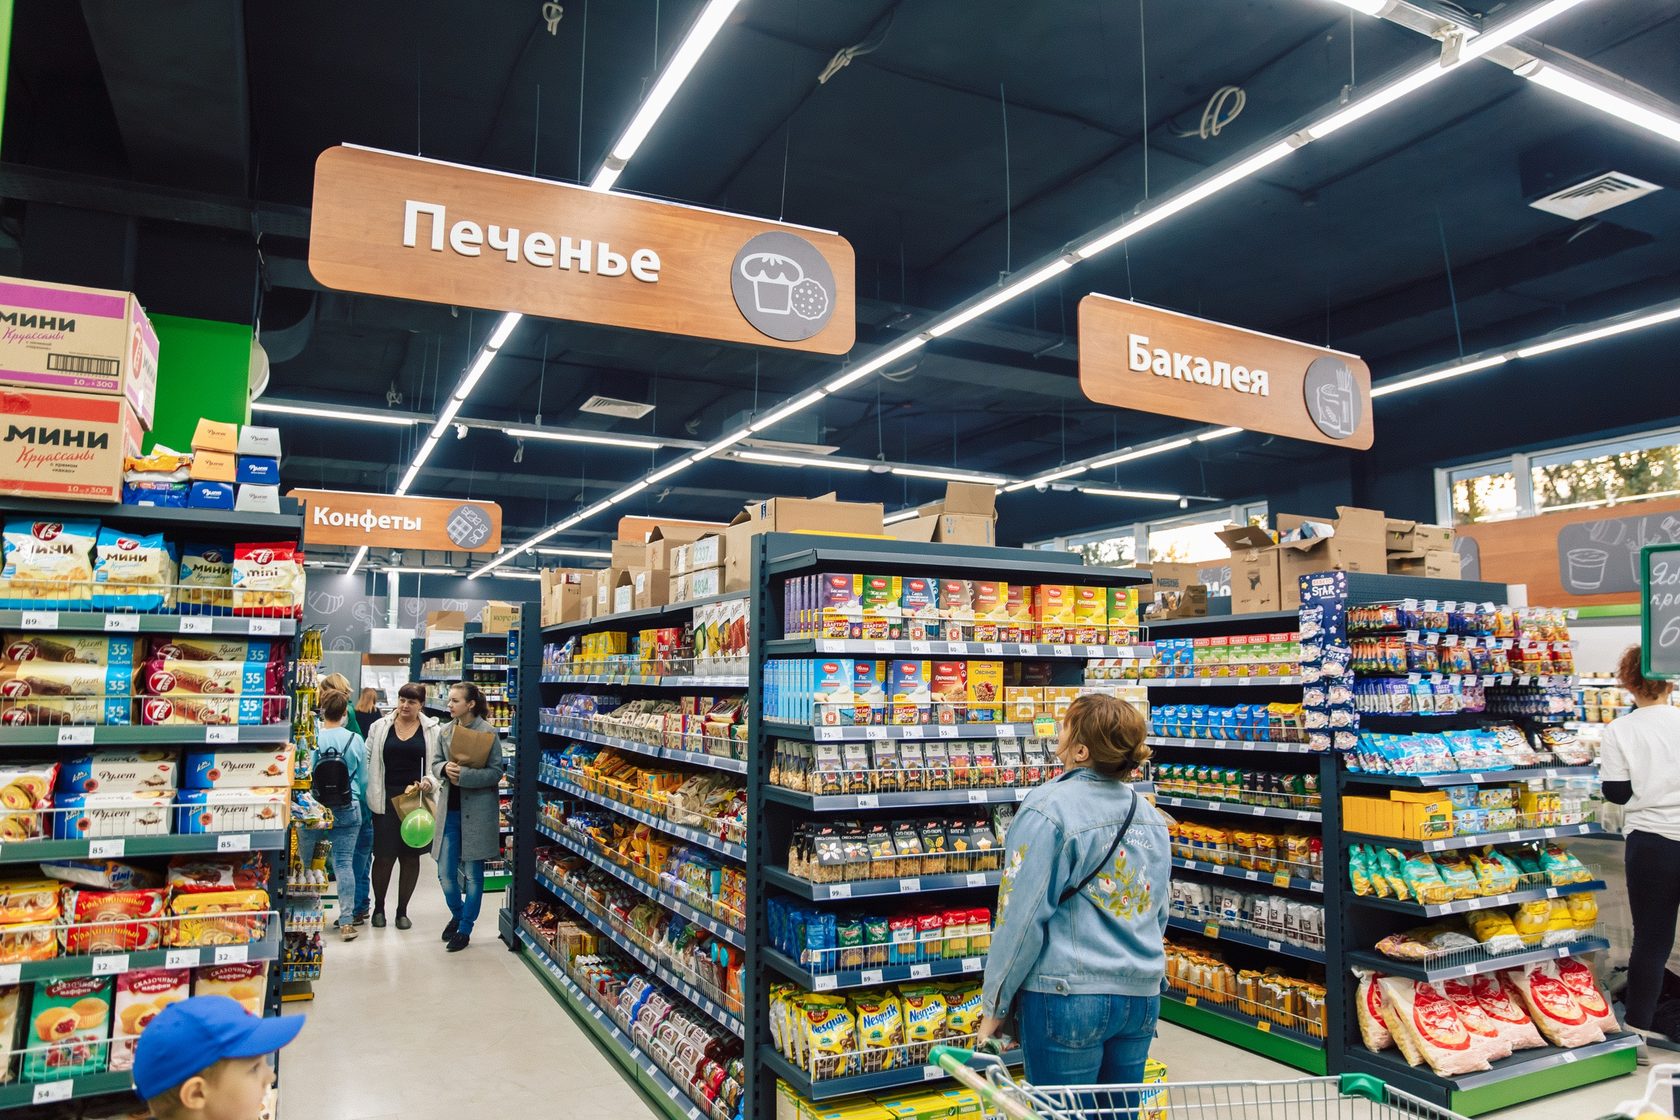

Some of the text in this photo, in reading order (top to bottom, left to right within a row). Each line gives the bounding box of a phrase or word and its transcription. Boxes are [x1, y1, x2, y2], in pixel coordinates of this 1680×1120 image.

[402, 199, 661, 284] Печенье
[0, 310, 76, 333] МИНИ
[2, 327, 65, 344] Круассаны
[1127, 333, 1270, 396] Бакалея
[73, 378, 85, 386] 10
[96, 380, 114, 388] 300
[3, 425, 109, 449] МИНИ
[16, 446, 95, 468] Круассаны
[90, 486, 108, 494] 300
[313, 507, 422, 532] Конфеты
[105, 553, 148, 562] МИНИ
[192, 564, 231, 574] МИНИ
[1311, 585, 1336, 597] STAR
[111, 643, 128, 655] 35
[250, 650, 265, 661] 35
[245, 672, 261, 684] 35
[109, 680, 126, 691] 35
[242, 699, 258, 711] 35
[107, 706, 125, 718] 35
[221, 760, 256, 772] Рулет
[99, 770, 136, 782] Рулет
[92, 809, 131, 820] Рулет
[169, 957, 181, 965] 32
[210, 966, 252, 976] СКАЗОЧНЫЙ
[133, 976, 179, 989] СКАЗОЧНЫЙ
[863, 1004, 898, 1029] Nesquik
